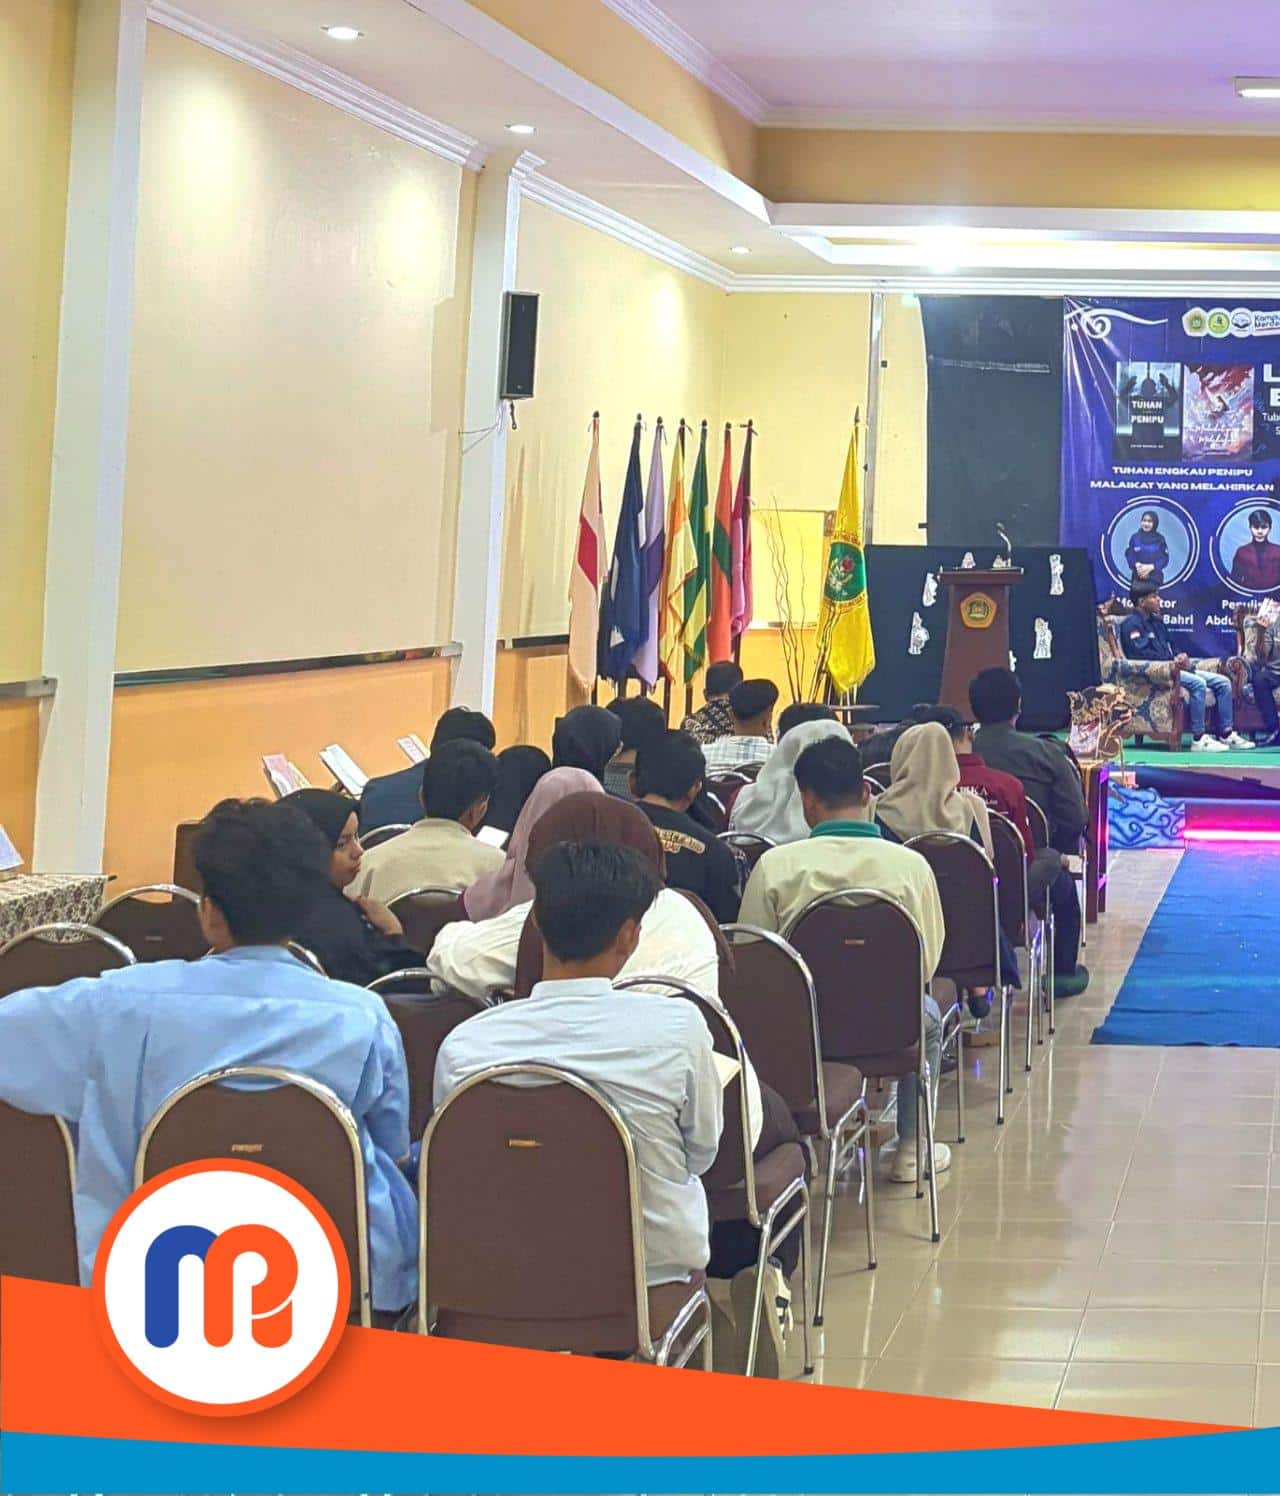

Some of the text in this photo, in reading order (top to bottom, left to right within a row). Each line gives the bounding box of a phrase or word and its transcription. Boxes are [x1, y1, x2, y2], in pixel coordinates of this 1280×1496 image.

[1131, 400, 1163, 409] TUHAN
[1130, 415, 1165, 425] PENIPU
[1112, 466, 1253, 477] TUHAN ENGKAU PENIPU
[1089, 480, 1275, 492] MALAIKAT YANG MELAHIRKAN
[1115, 597, 1177, 609] Motor
[1163, 614, 1194, 625] Bahri
